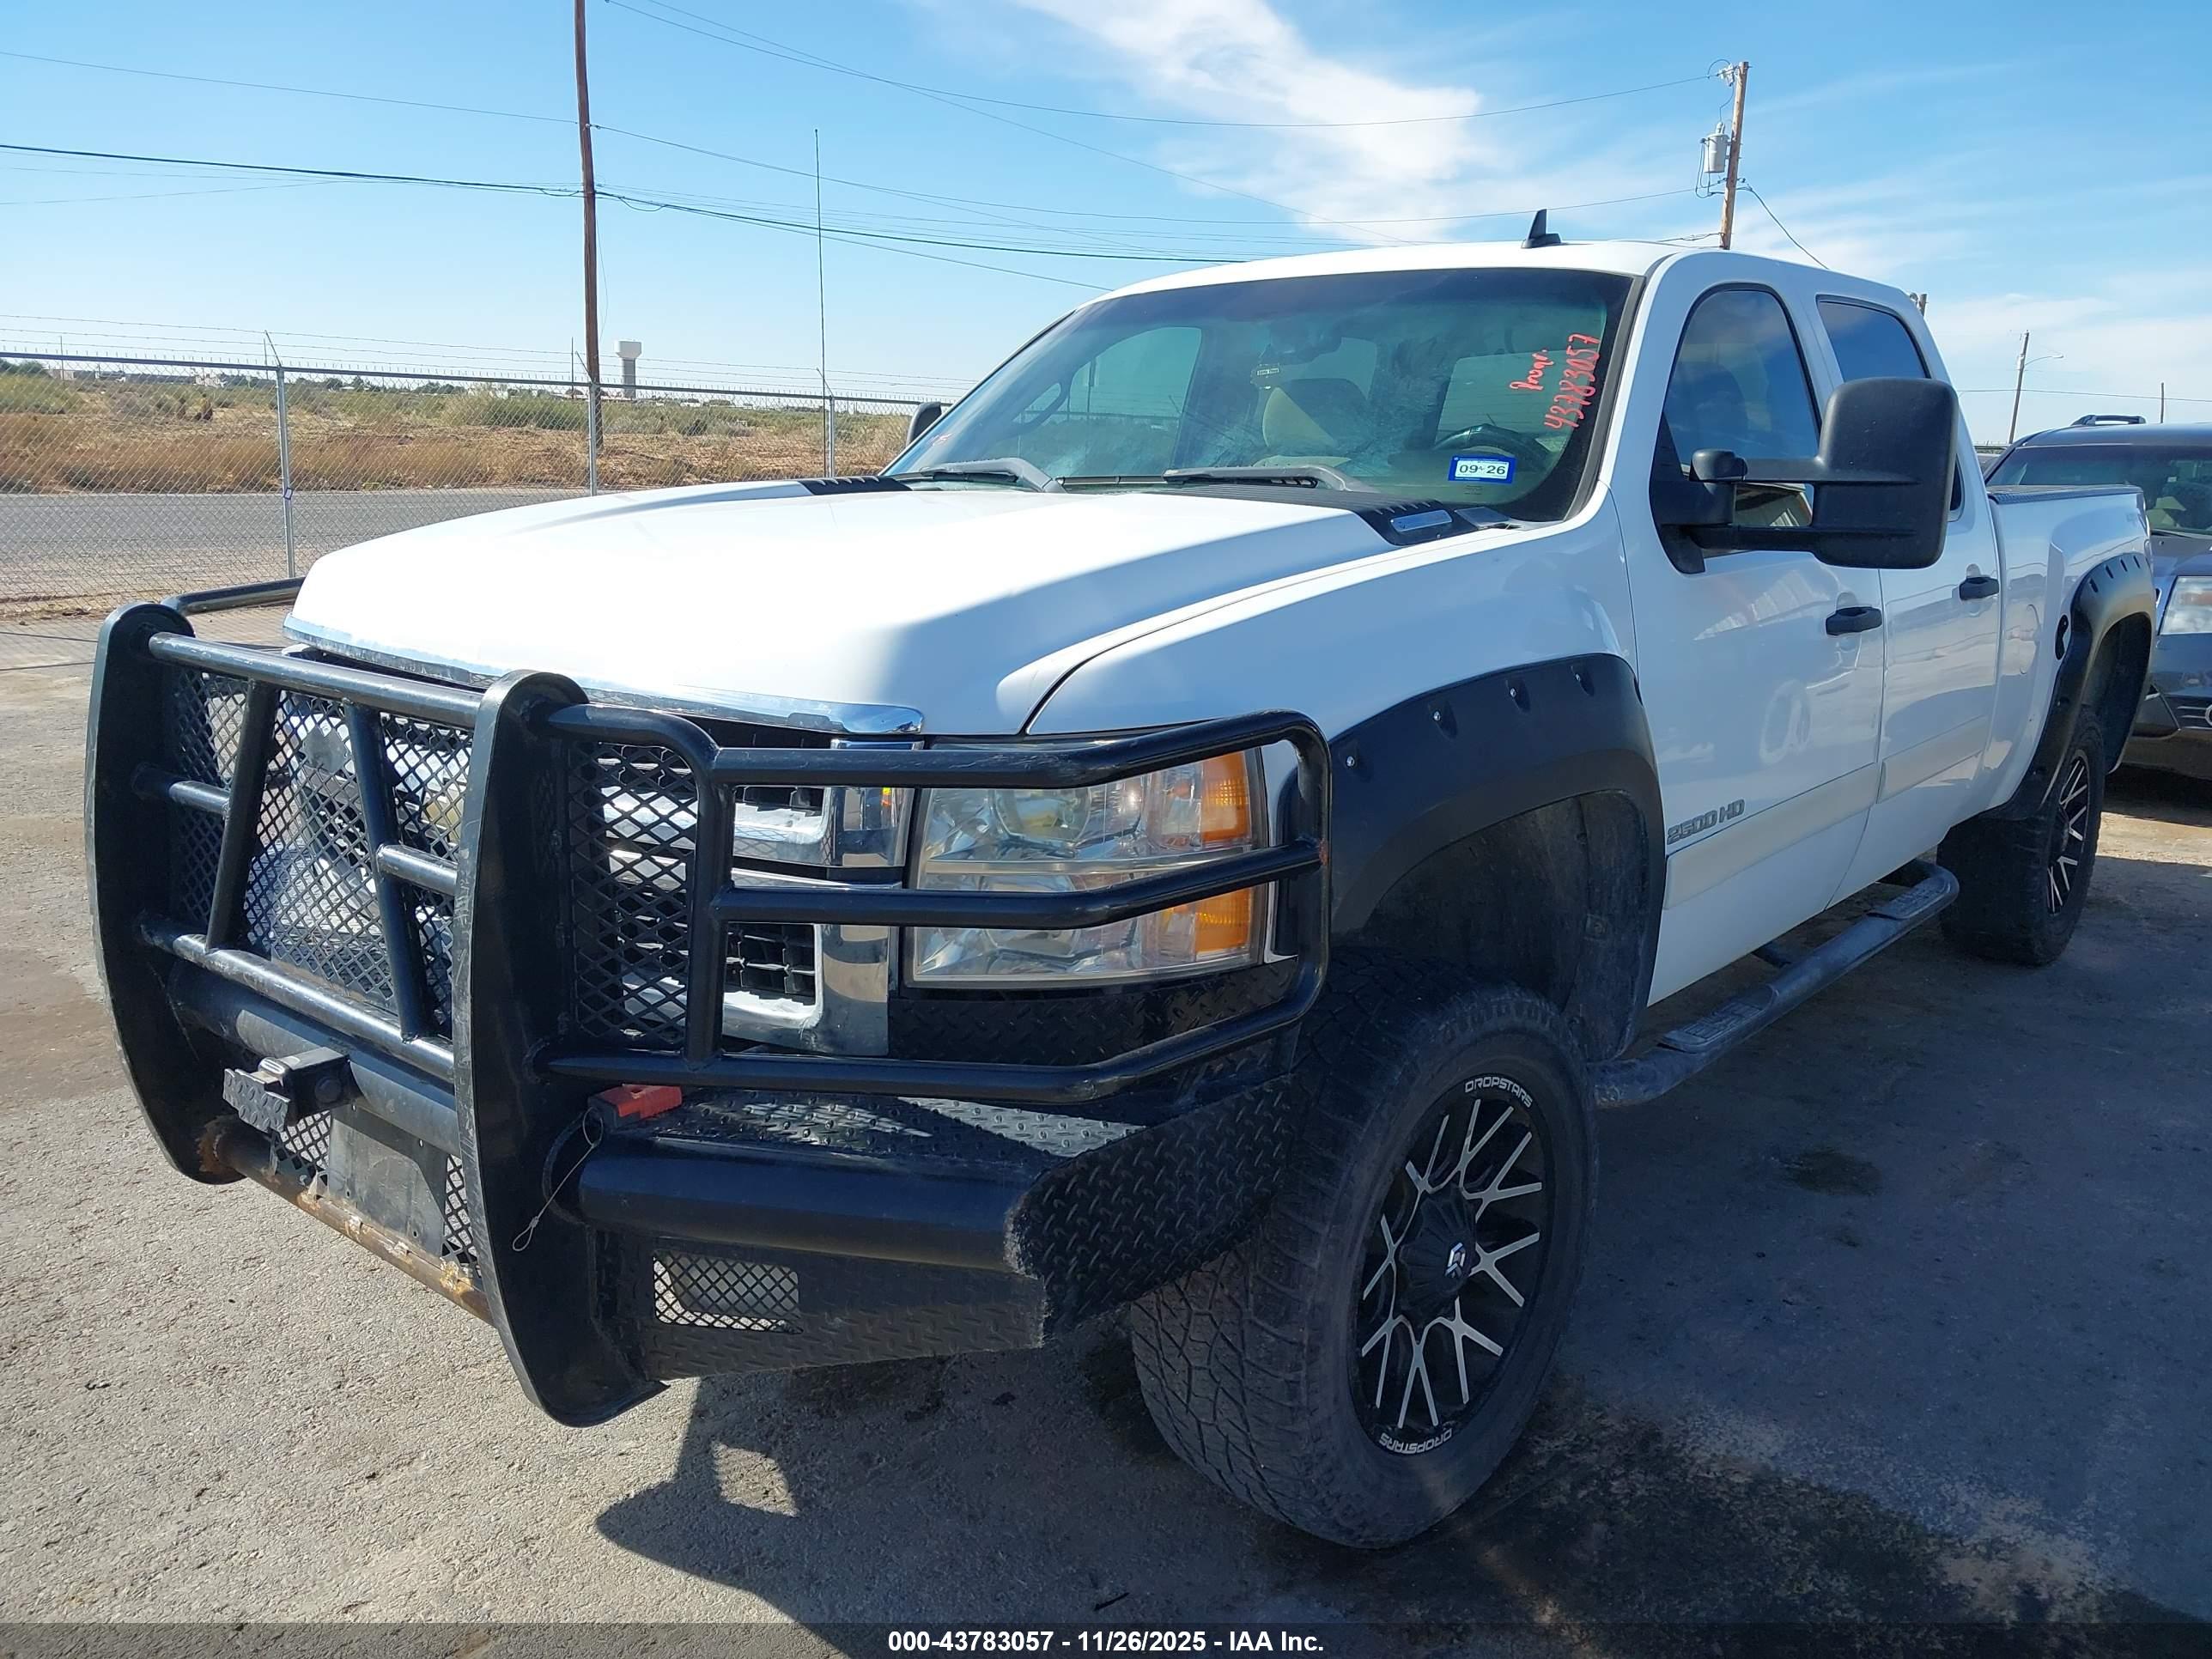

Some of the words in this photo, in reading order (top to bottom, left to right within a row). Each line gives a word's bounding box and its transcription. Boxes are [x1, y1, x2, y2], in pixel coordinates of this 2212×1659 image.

[1543, 332, 1601, 429] 43783057
[1459, 465, 1479, 473] 09
[1486, 465, 1506, 475] 26
[1667, 810, 1718, 845] 2500
[1718, 798, 1746, 823] HD
[1464, 1076, 1533, 1108] DROPSTARS
[1378, 1427, 1453, 1455] DROPSTARS
